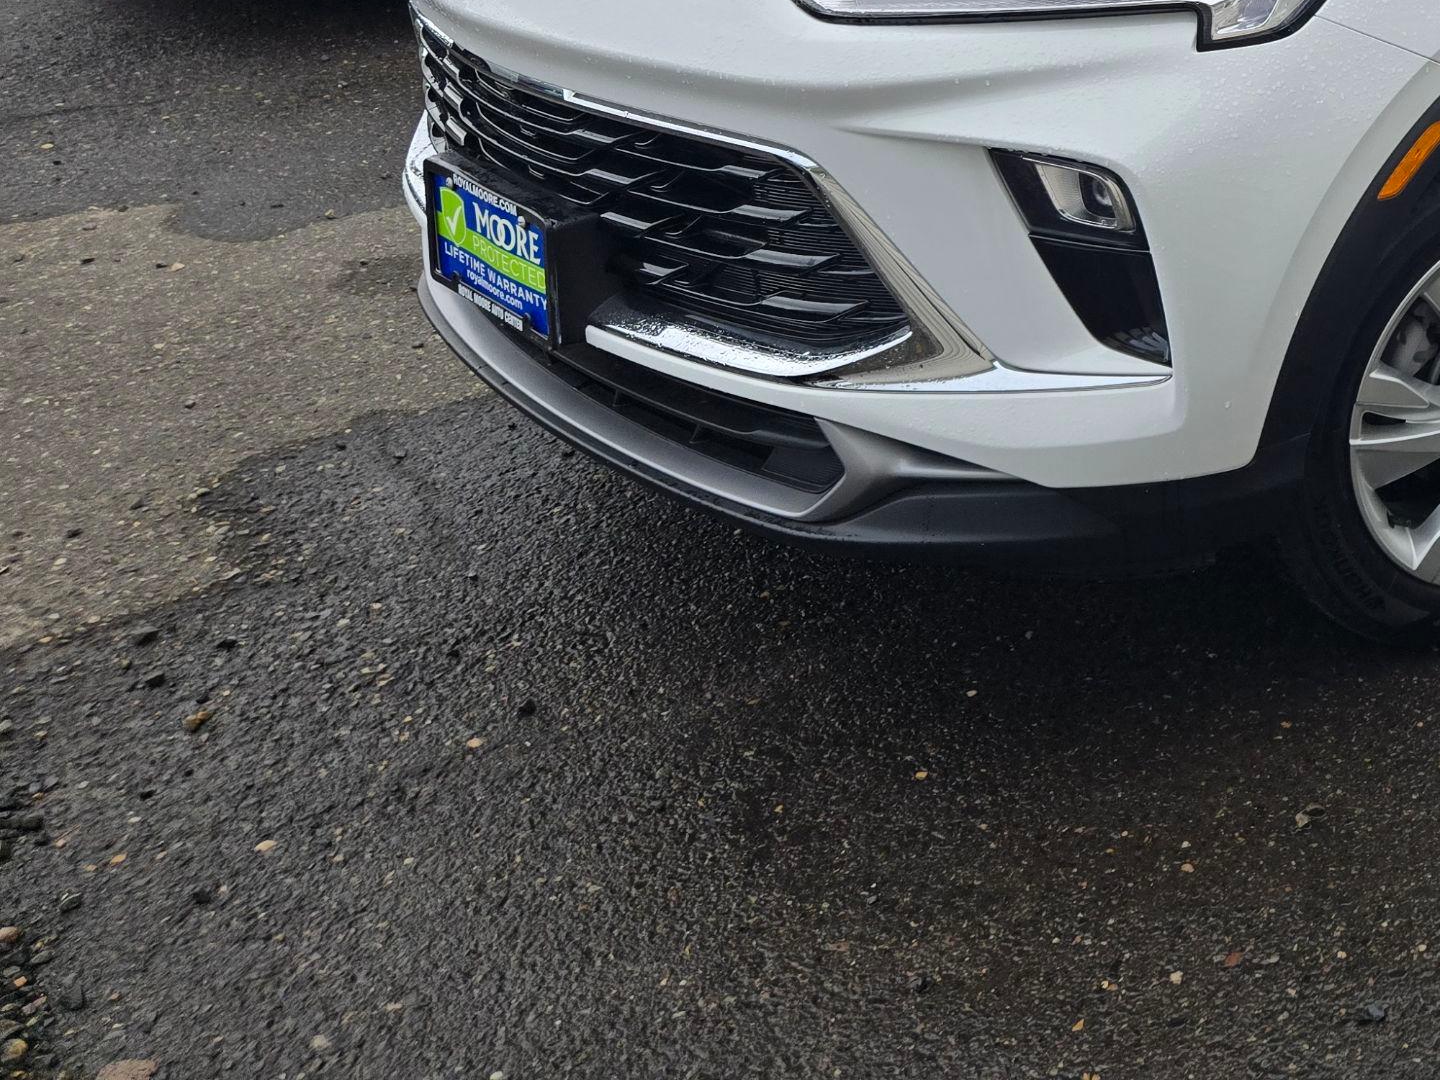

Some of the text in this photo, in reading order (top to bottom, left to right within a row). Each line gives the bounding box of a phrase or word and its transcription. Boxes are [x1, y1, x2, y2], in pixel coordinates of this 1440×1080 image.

[453, 173, 517, 216] ROYALMOORE.COM
[472, 202, 541, 265] MOORE
[444, 242, 547, 310] LIFETIME WARRANTY
[473, 235, 546, 289] PROTECTED
[466, 269, 523, 310] royalmoore.com
[473, 293, 491, 312] MOORE
[491, 303, 504, 320] AUTO
[504, 311, 523, 331] CENTER
